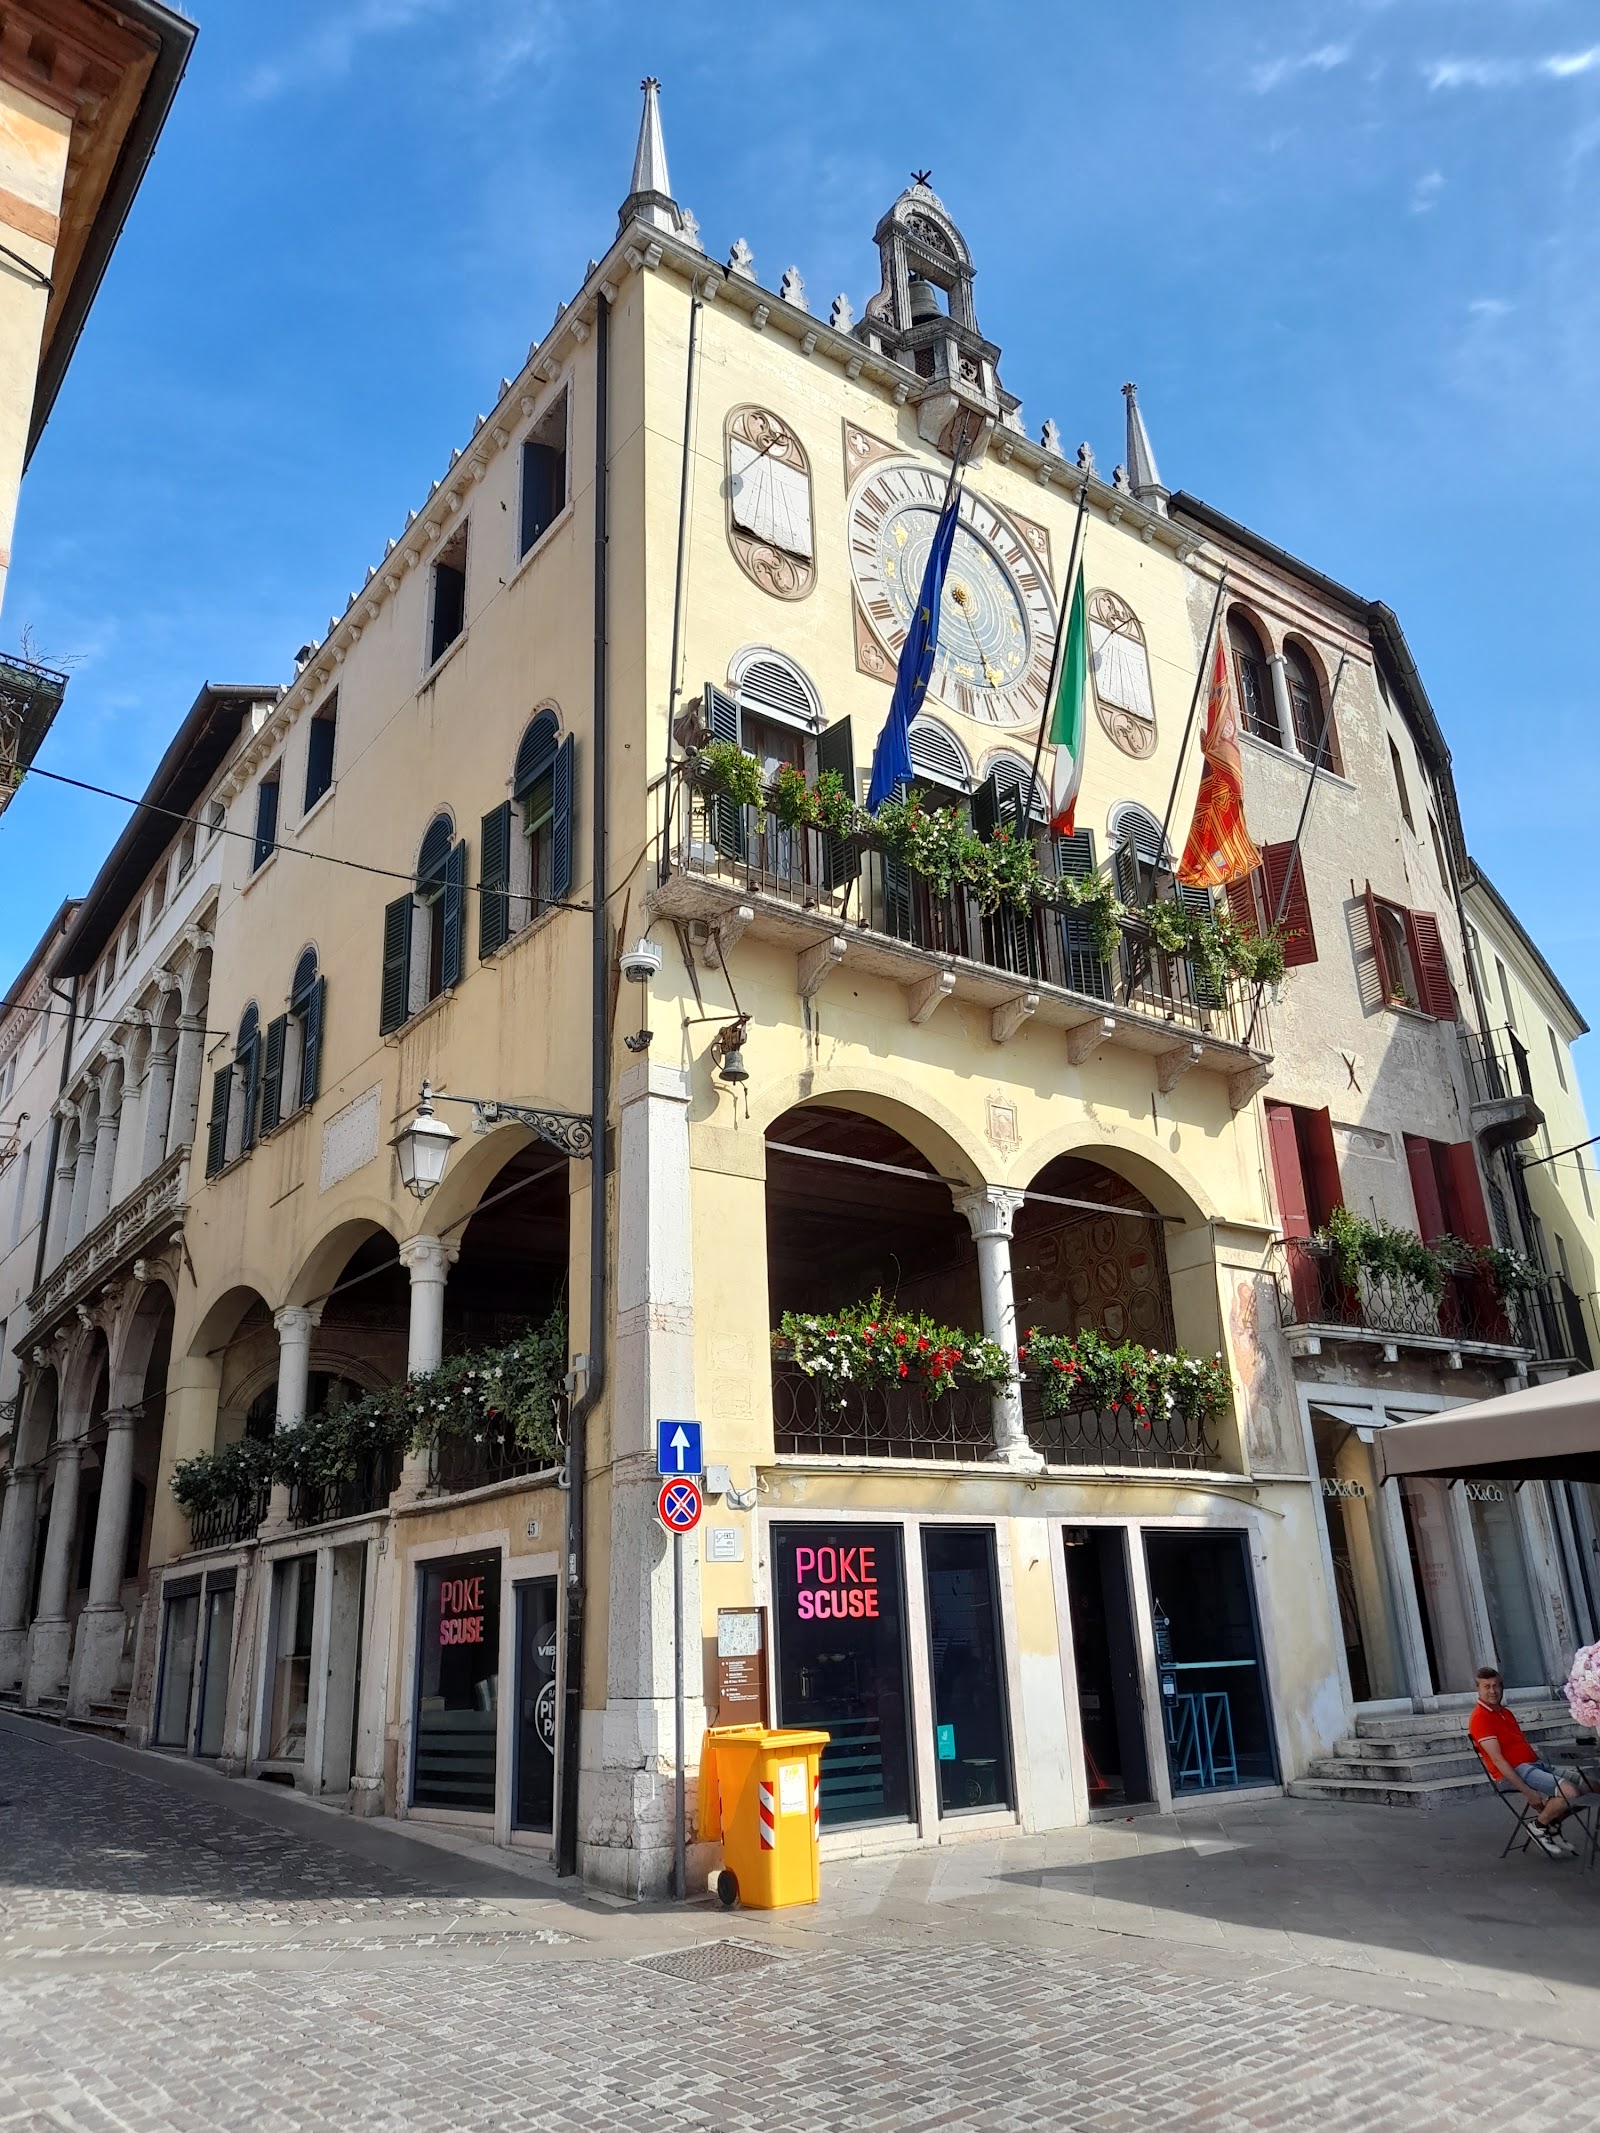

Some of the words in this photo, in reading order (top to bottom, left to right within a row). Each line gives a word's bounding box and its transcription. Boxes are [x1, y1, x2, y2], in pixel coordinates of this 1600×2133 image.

[796, 1546, 878, 1584] POKE
[440, 1576, 484, 1614] POKE
[798, 1588, 879, 1620] SCUSE
[440, 1616, 484, 1646] SCUSE
